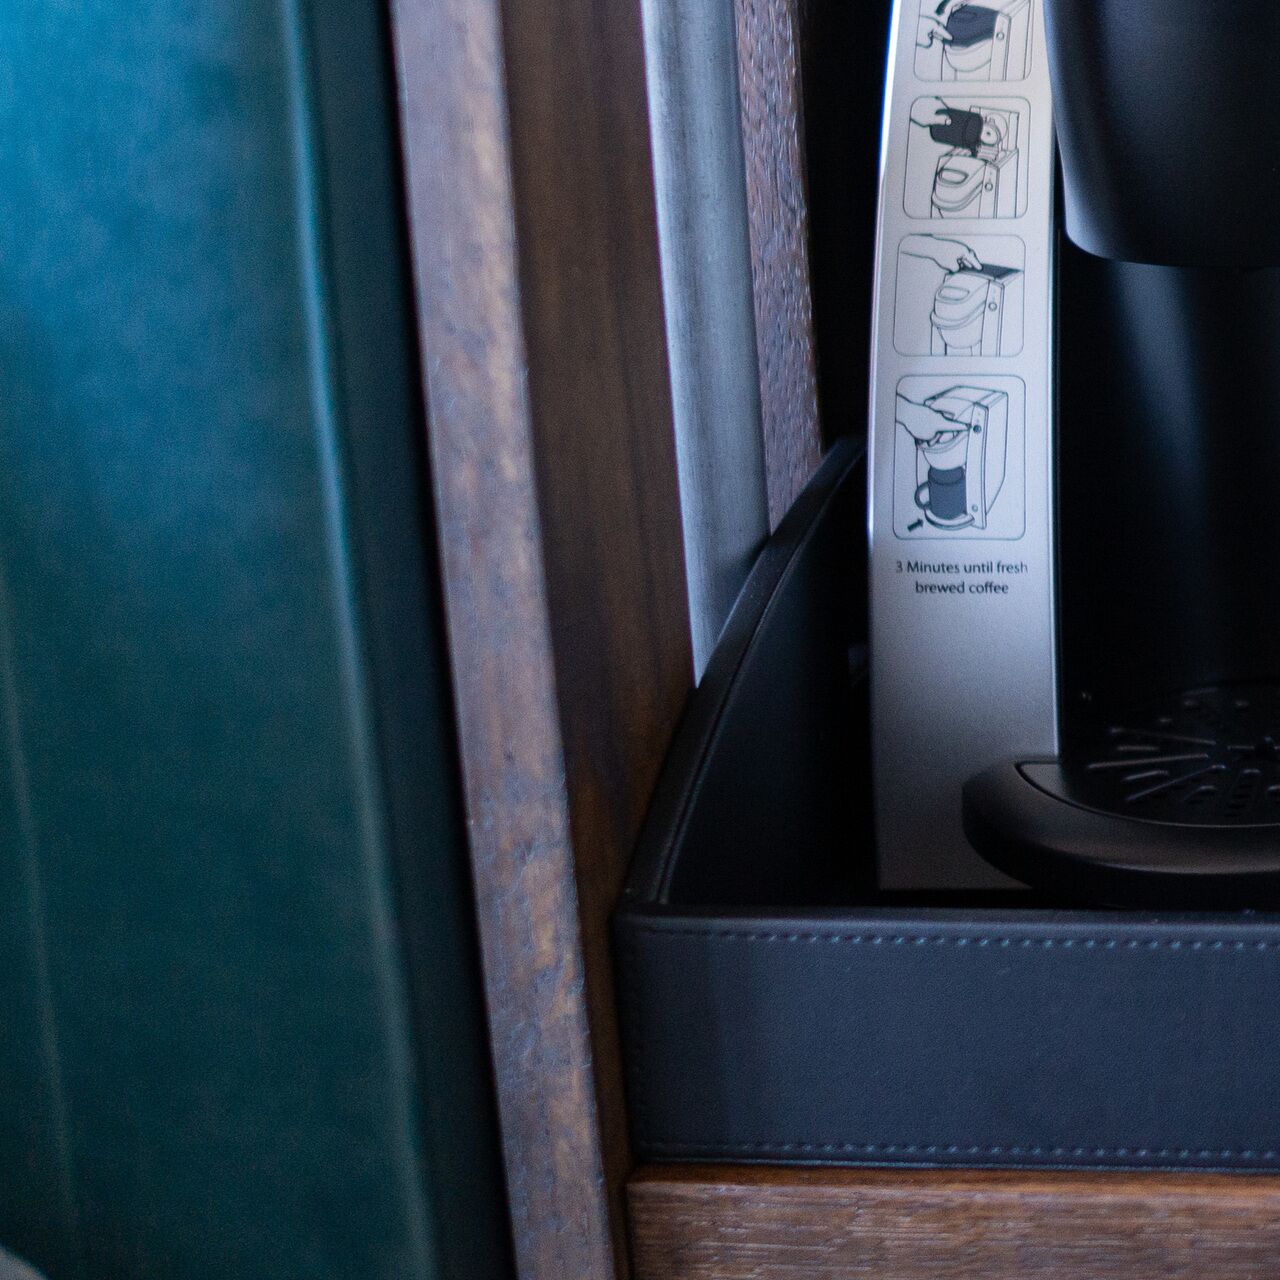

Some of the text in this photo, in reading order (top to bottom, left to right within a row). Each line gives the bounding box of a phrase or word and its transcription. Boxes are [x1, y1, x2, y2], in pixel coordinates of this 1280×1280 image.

[906, 560, 960, 574] Minutes
[963, 560, 994, 574] until
[996, 560, 1029, 574] fresh
[915, 581, 1009, 594] brewed coffee
